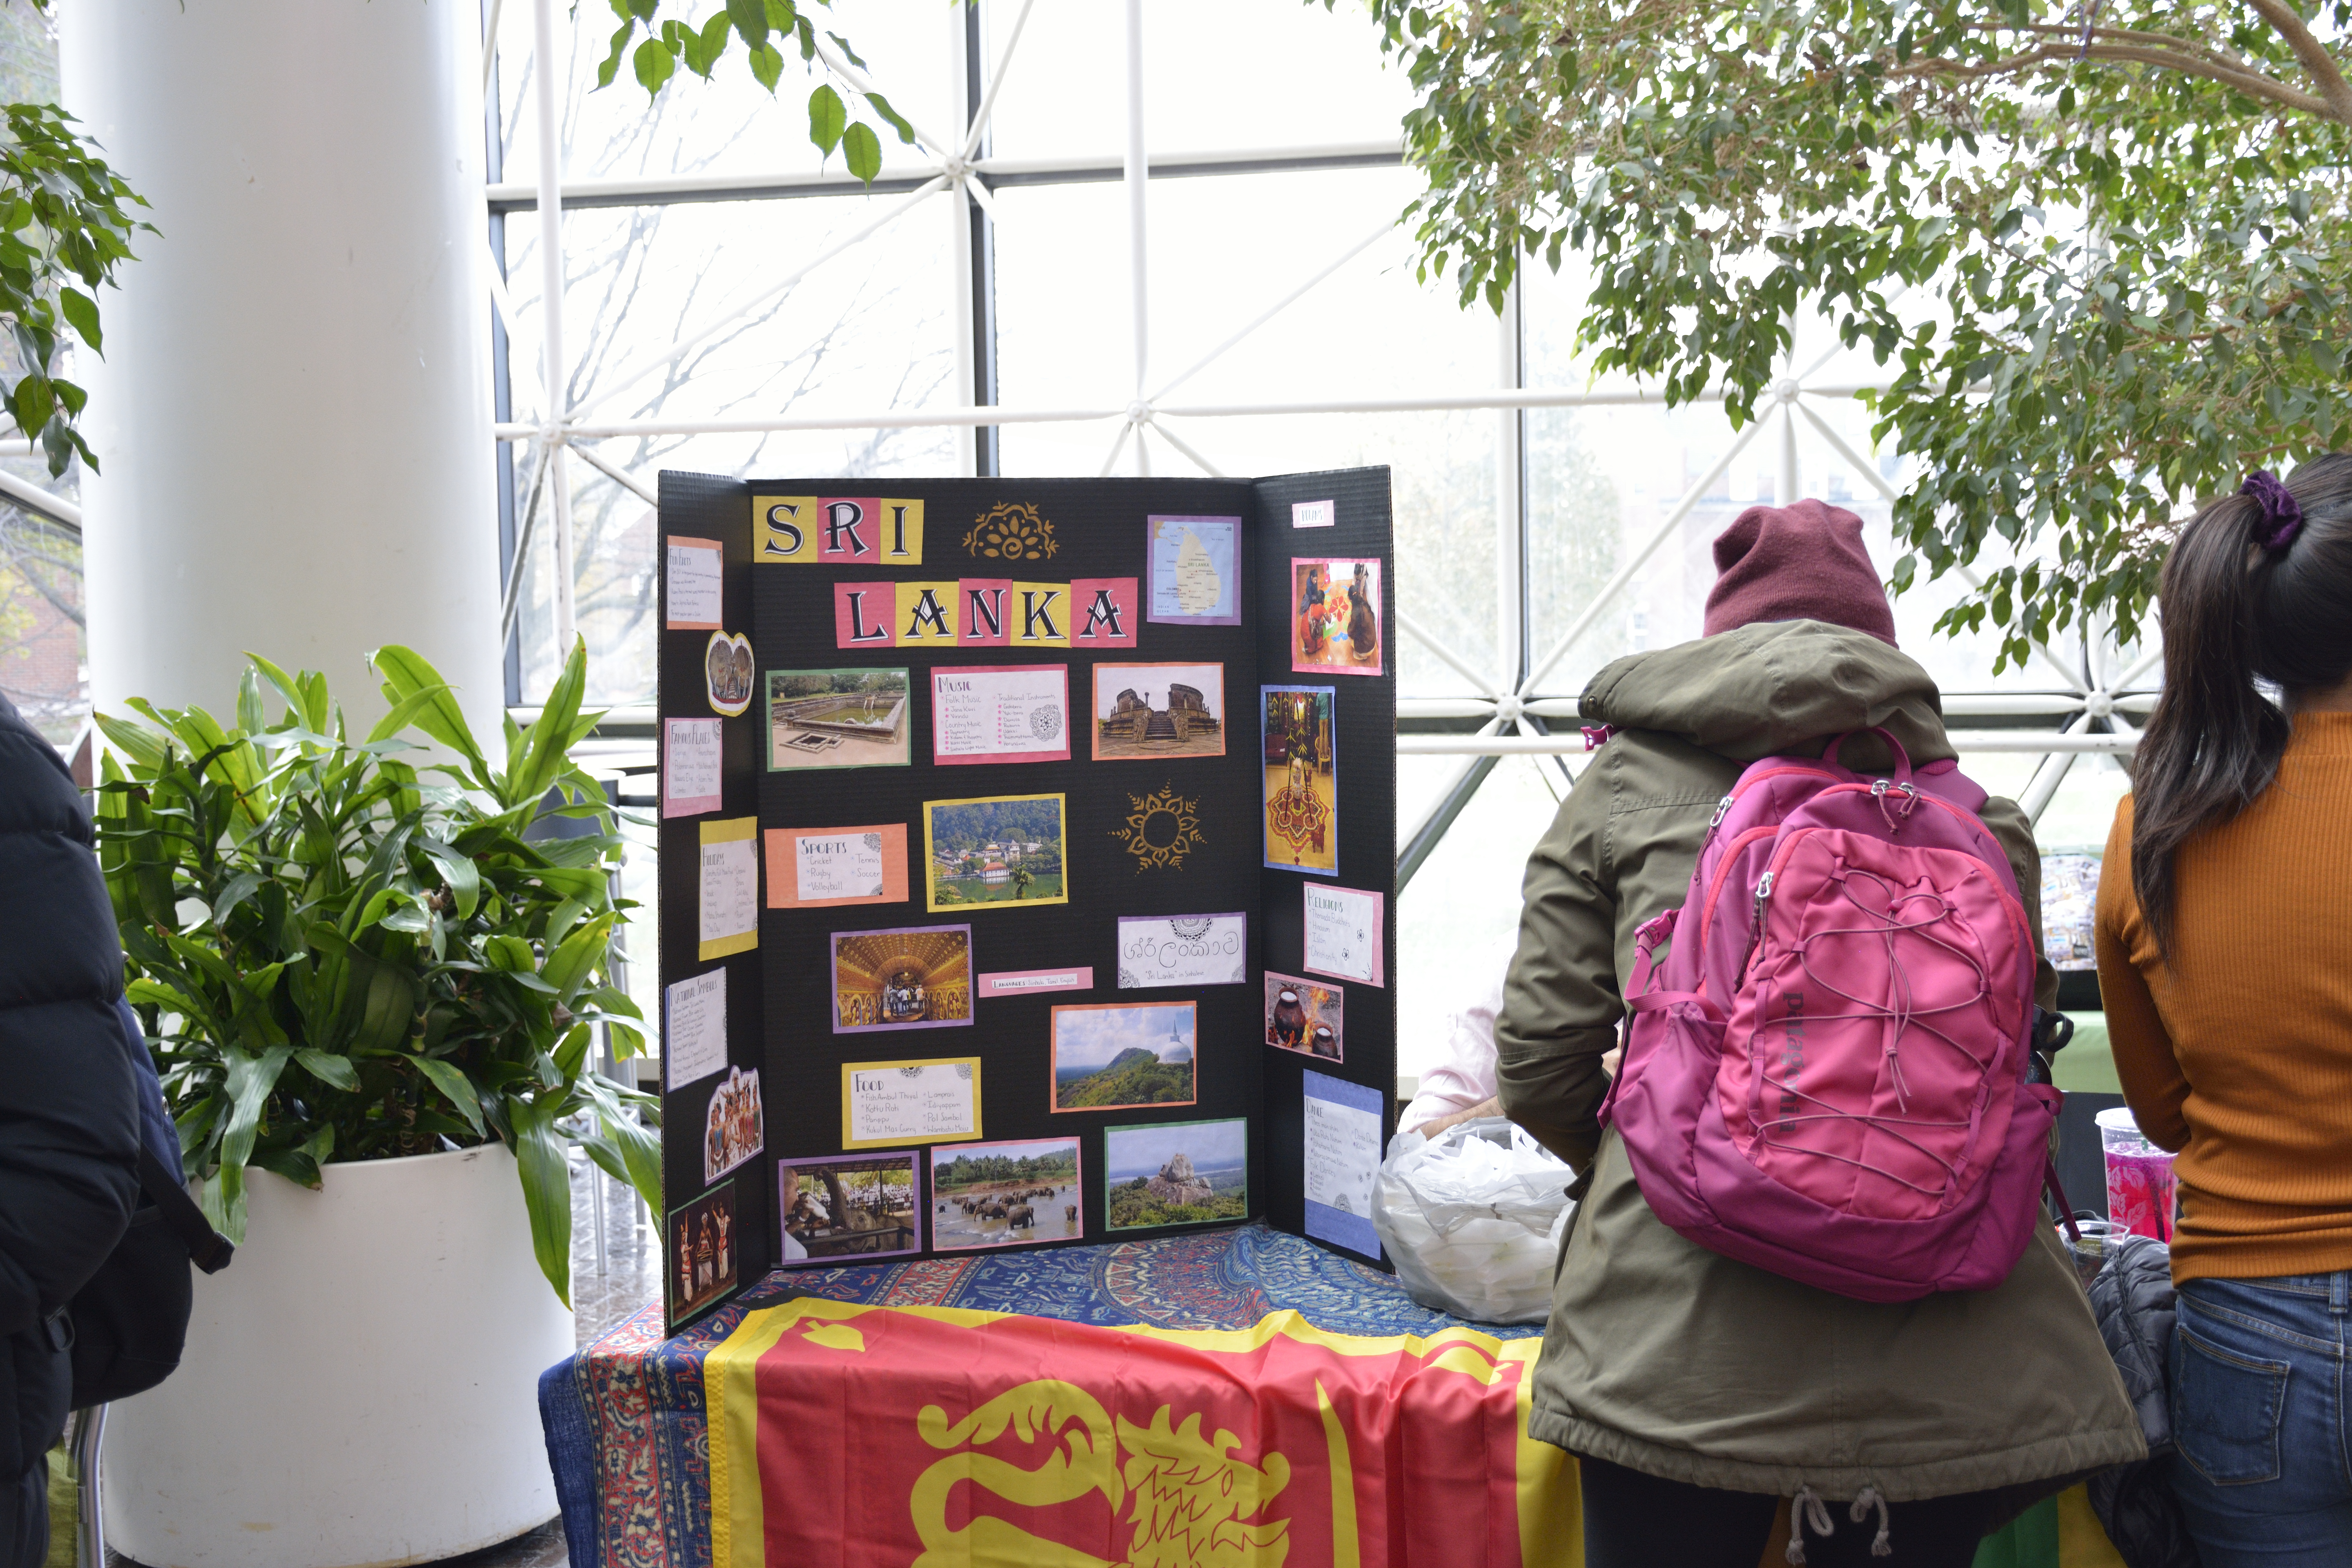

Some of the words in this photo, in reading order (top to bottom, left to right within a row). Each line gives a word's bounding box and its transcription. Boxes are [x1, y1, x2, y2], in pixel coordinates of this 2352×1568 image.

[1302, 509, 1322, 521] KOLAMS
[764, 500, 910, 557] SRI
[679, 549, 691, 566] FACTS
[844, 588, 1129, 642] LANKA
[946, 695, 960, 704] Folk
[962, 694, 981, 703] Music
[945, 720, 966, 730] Country
[671, 725, 691, 745] FAMOUS
[692, 724, 710, 744] PLACES
[802, 838, 847, 855] SPORTS
[703, 847, 724, 867] HOLIDAYS
[810, 855, 832, 866] Cricket
[855, 853, 879, 864] Tennis
[811, 867, 831, 880] Rugby
[857, 867, 880, 877] Soccer
[811, 881, 843, 893] Volleyball
[1308, 887, 1343, 913] RELIGIONS
[1331, 912, 1350, 927] Buddhists
[1313, 920, 1330, 933] Hinduism
[1312, 932, 1326, 945] Islam
[1311, 945, 1337, 965] Christianity
[670, 987, 695, 1007] NATIONAL
[697, 978, 717, 995] SYMBOLS
[1779, 992, 1806, 1132] patagonia
[855, 1073, 884, 1092] FOOD
[878, 1092, 897, 1100] Ambul
[899, 1091, 918, 1100] Thiyal
[866, 1104, 883, 1113] Kottu
[885, 1103, 899, 1112] Roti
[927, 1100, 960, 1110] Idiyappam
[1306, 1098, 1324, 1118] DANCE
[927, 1112, 938, 1122] Pol
[941, 1112, 962, 1121] Sambol
[866, 1125, 882, 1134] Kukul
[900, 1123, 916, 1135] Curry
[927, 1125, 954, 1133] Wambatu
[955, 1124, 969, 1132] Moju
[1355, 1129, 1366, 1142] Dance
[1366, 1132, 1379, 1147] Drama
[1310, 1158, 1319, 1170] Folk
[1319, 1161, 1336, 1177] Dances
